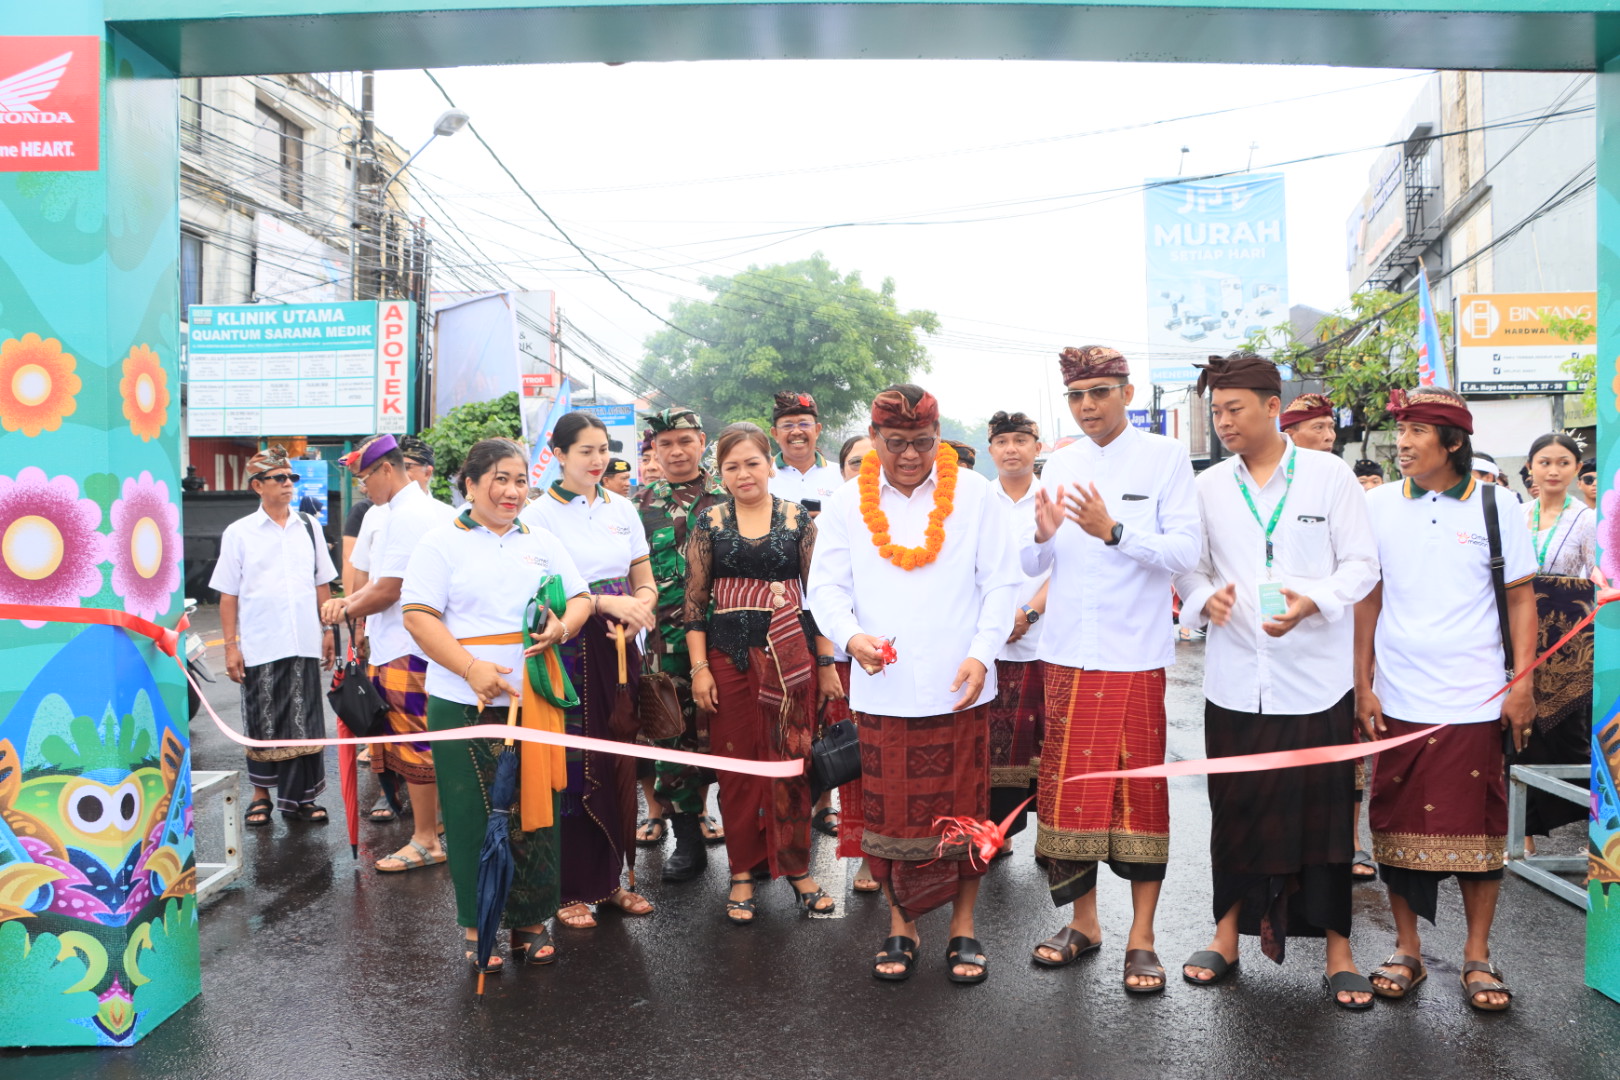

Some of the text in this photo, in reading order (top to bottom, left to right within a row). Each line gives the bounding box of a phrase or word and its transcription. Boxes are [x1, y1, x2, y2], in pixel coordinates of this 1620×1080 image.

[20, 140, 75, 157] HEART.
[1154, 220, 1280, 246] MURAH
[1170, 248, 1266, 261] SETIAP HARI
[217, 310, 278, 326] KLINIK
[282, 308, 345, 324] UTAMA
[1509, 304, 1592, 322] BINTANG
[192, 325, 373, 342] QUANTUM SARANA MEDIK
[383, 304, 404, 414] APOTEK
